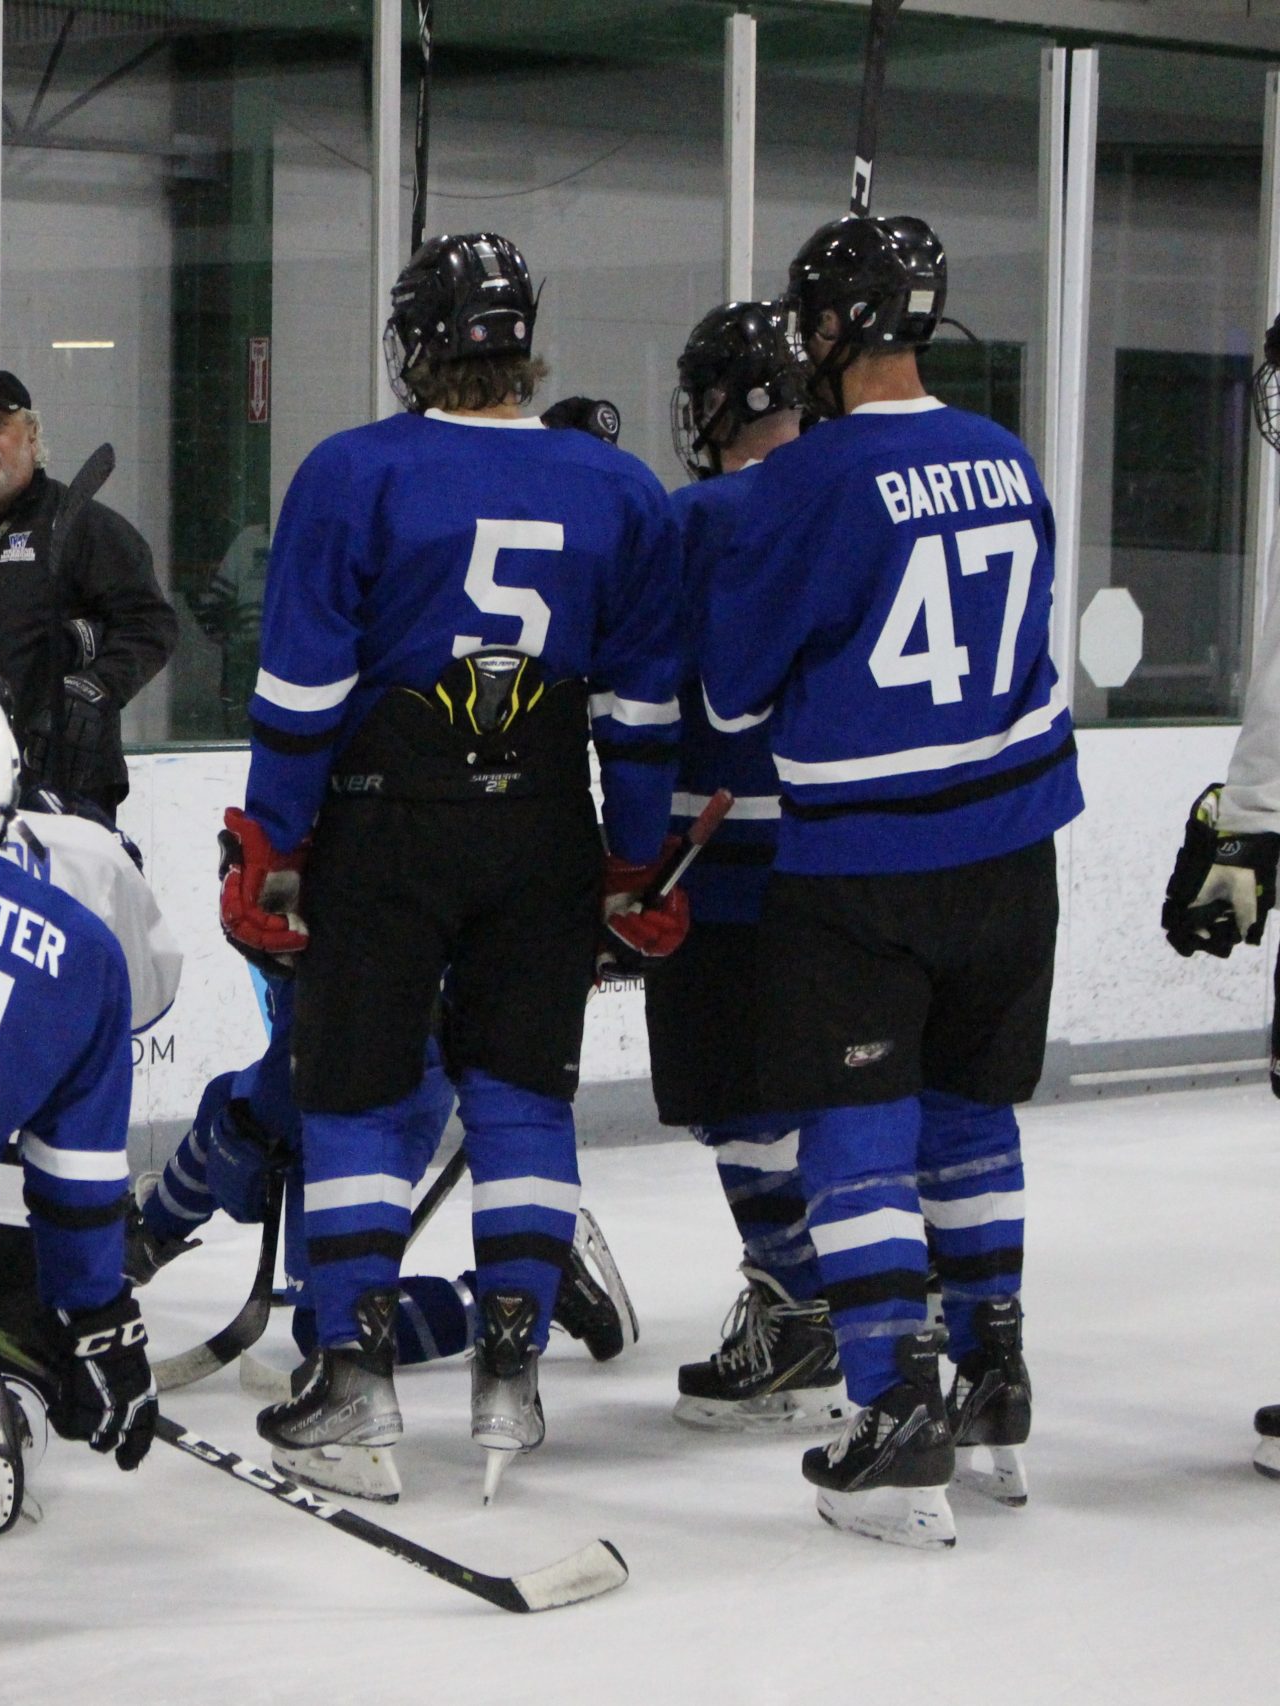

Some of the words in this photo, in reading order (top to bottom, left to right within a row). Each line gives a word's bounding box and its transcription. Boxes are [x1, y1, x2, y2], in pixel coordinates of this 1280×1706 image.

[875, 459, 1033, 524] BARTON
[452, 518, 564, 659] 5
[868, 519, 1038, 705] 47
[471, 773, 521, 783] SUPREME
[176, 1431, 345, 1520] CCM
